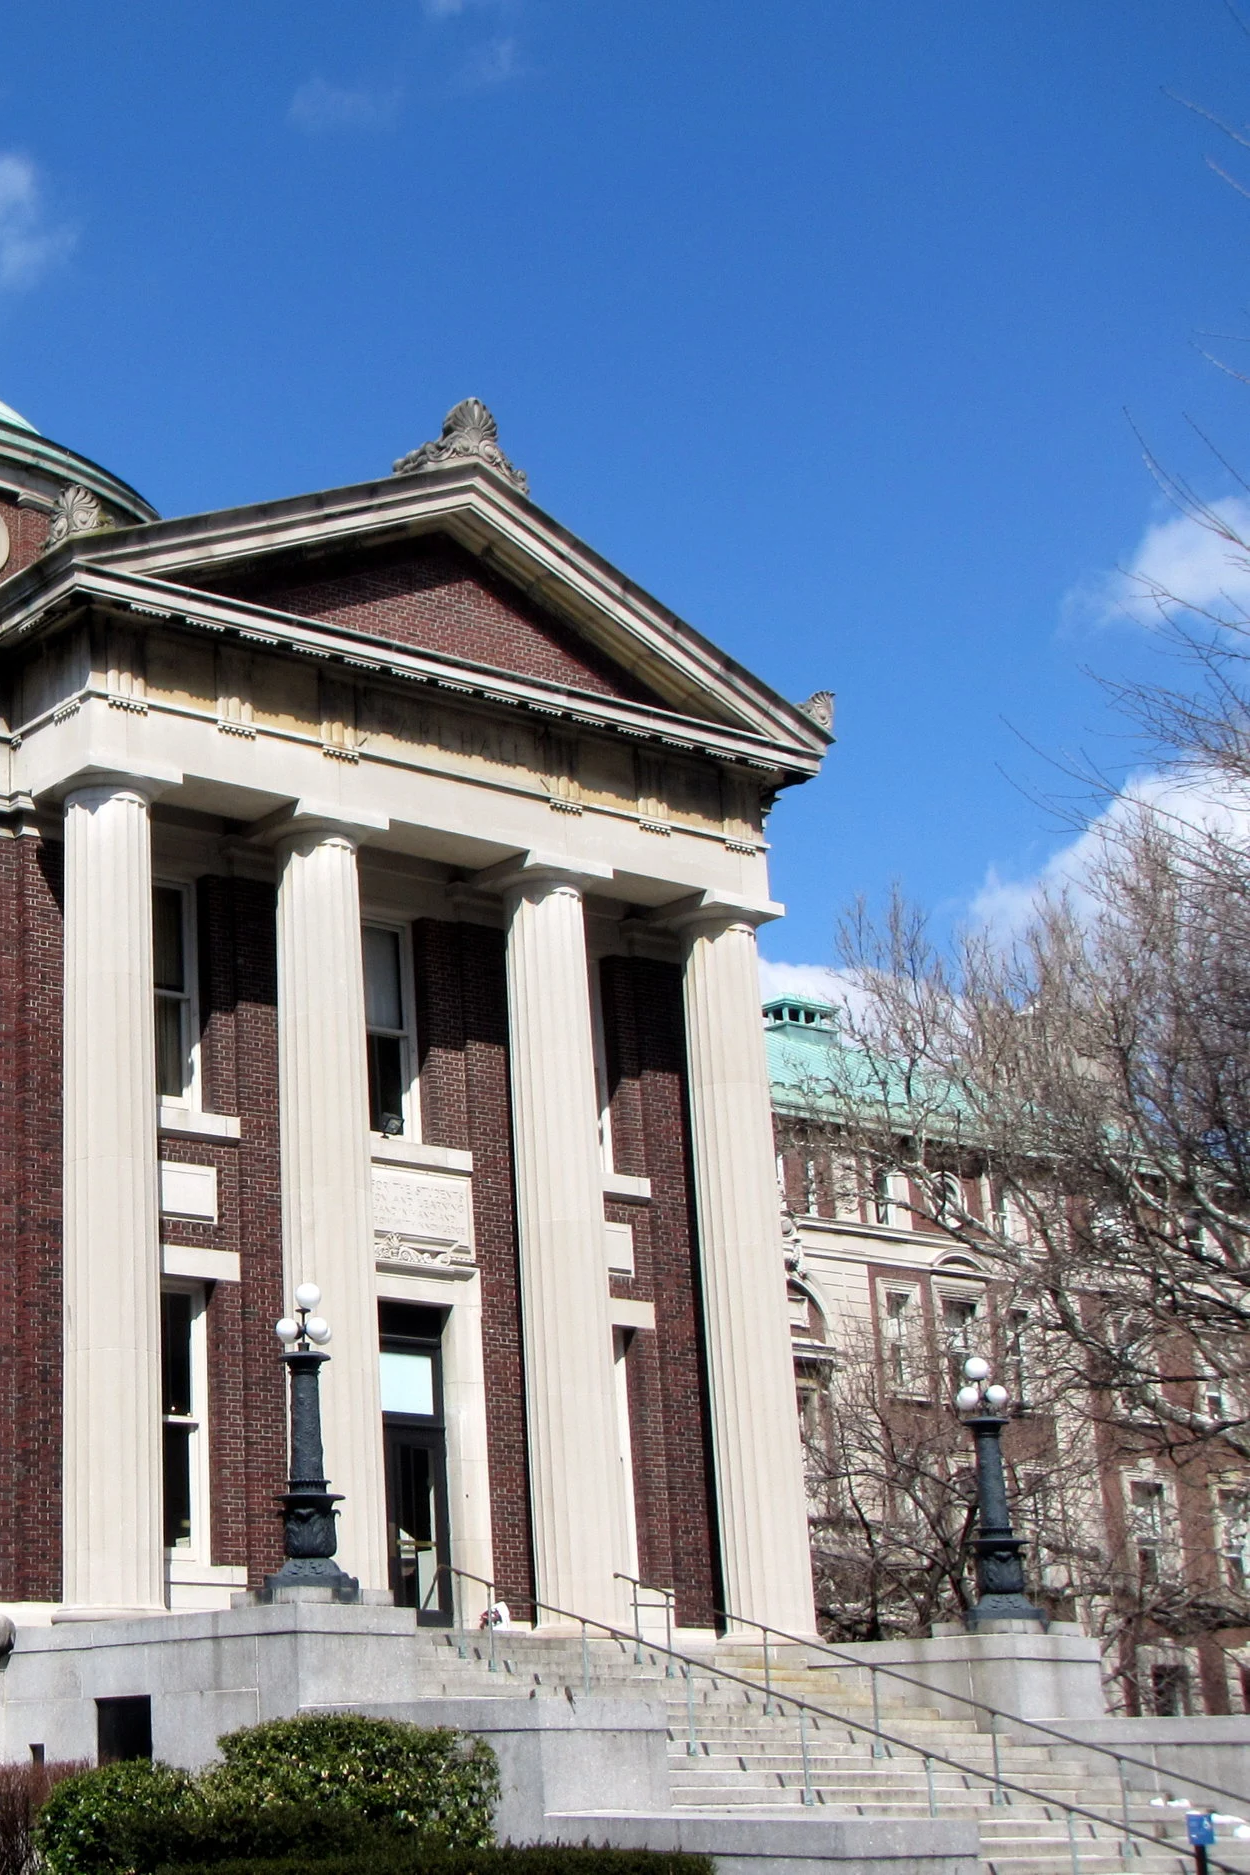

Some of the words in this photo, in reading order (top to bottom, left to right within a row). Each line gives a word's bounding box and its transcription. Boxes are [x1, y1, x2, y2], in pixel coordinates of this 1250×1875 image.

[461, 729, 526, 766] HALL
[391, 1182, 411, 1195] THE
[415, 1186, 464, 1202] STUDENTS
[417, 1198, 464, 1213] LEARNING
